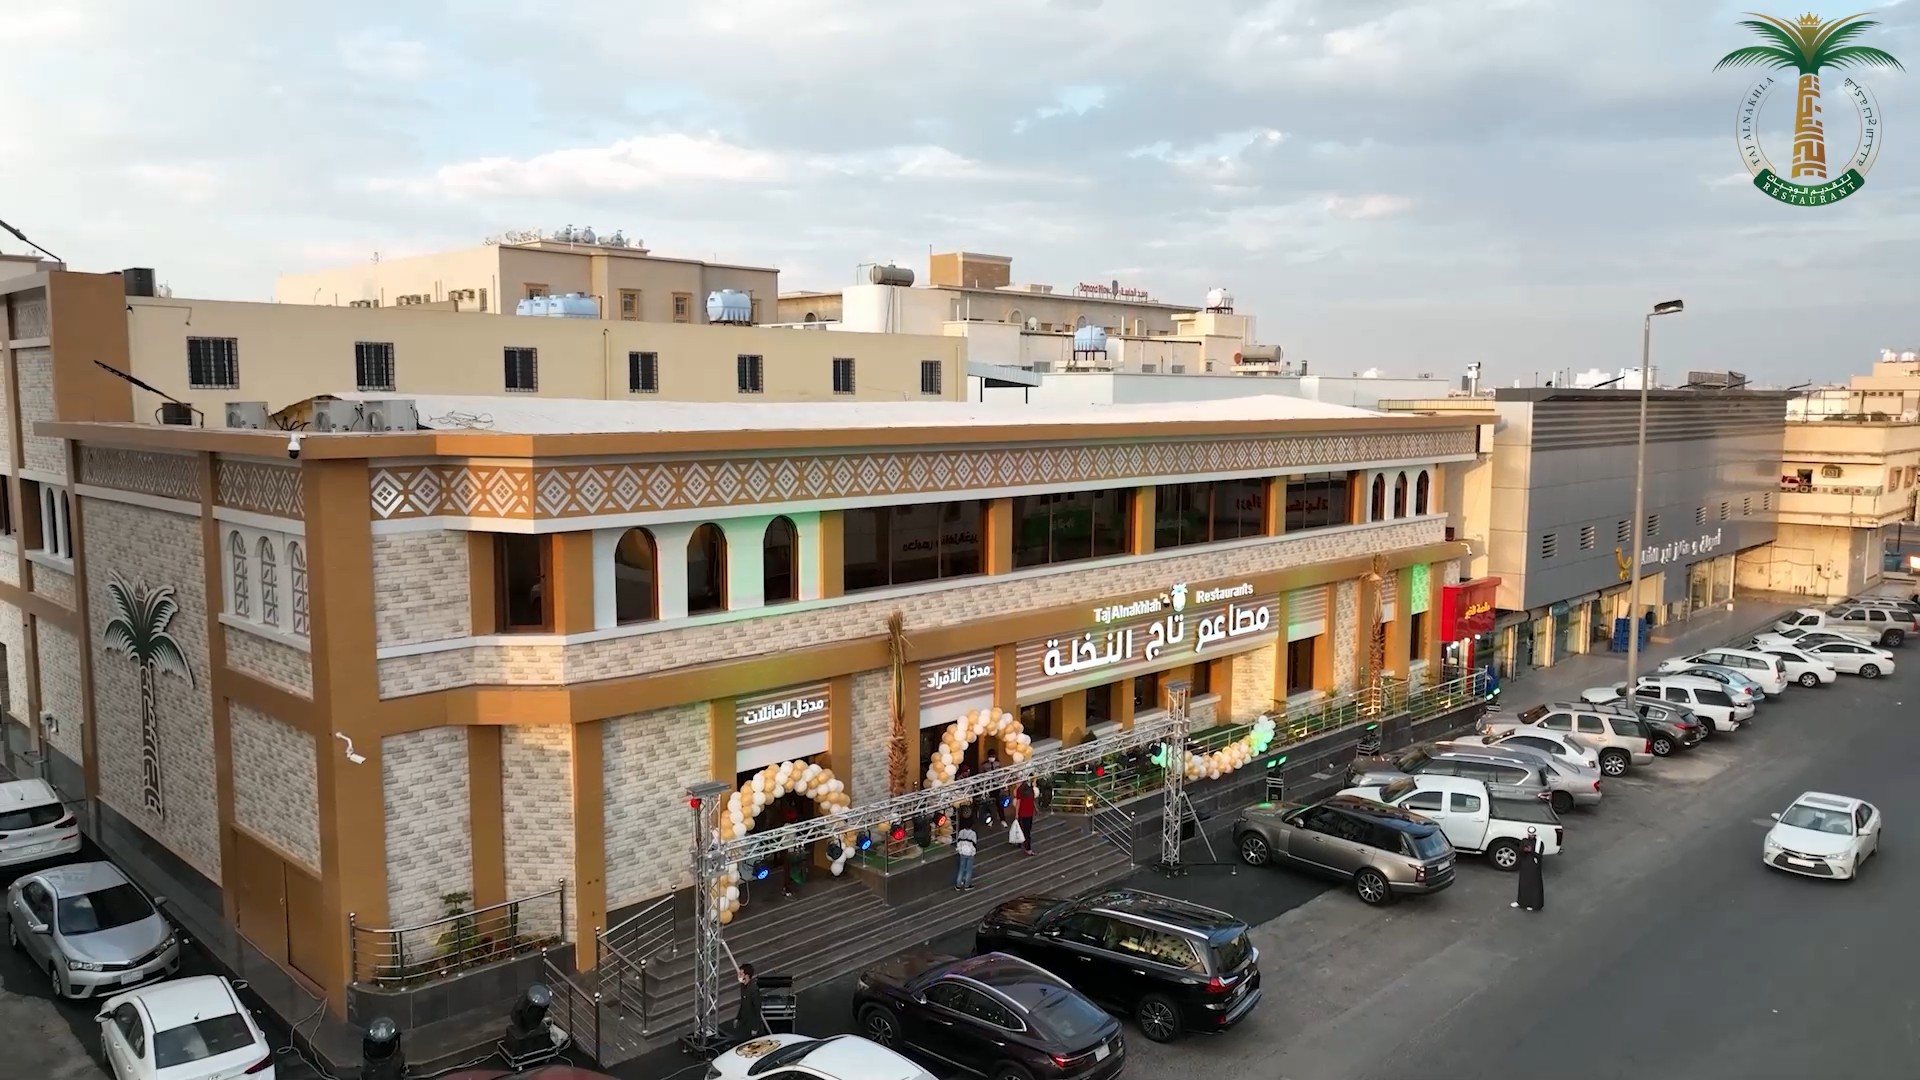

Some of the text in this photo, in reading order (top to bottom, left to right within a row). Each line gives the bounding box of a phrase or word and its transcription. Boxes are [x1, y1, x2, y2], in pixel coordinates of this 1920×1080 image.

[1093, 582, 1254, 624] Taj Alnakhlah Restaurants
[1044, 603, 1271, 676] مطاعم تاج النخلة
[962, 665, 991, 685] مدخل
[743, 698, 824, 726] مدخل العائلات
